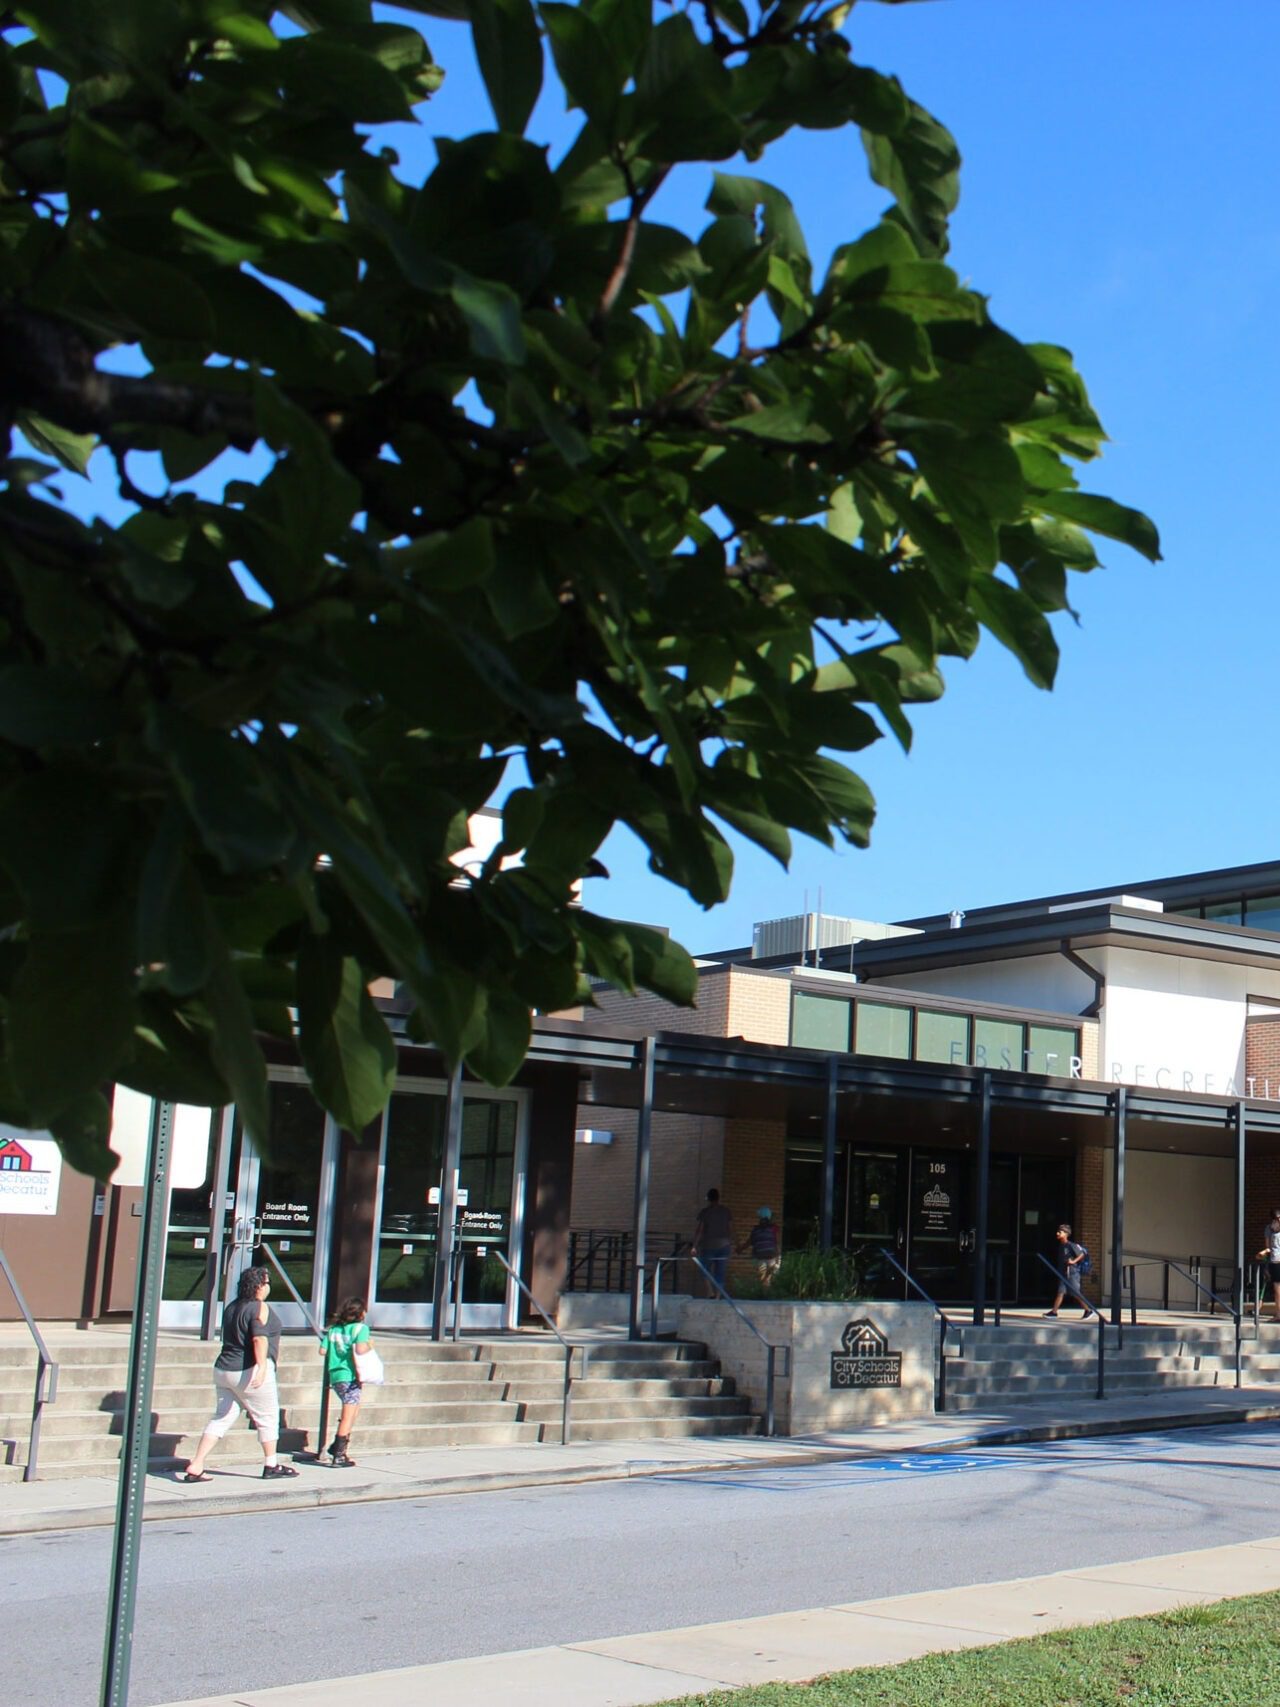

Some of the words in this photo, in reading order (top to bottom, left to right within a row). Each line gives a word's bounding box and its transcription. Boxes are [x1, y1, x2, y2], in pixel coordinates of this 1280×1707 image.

[930, 1163, 946, 1174] 105
[265, 1203, 286, 1211] Board
[288, 1203, 308, 1212] Room
[262, 1212, 292, 1221] Entrance
[294, 1213, 310, 1223] Only
[464, 1211, 483, 1220] Board
[484, 1212, 502, 1220] Room
[461, 1221, 488, 1229] Entrance
[489, 1222, 503, 1231] Only
[834, 1360, 857, 1375] City
[858, 1360, 899, 1372] Schools
[854, 1372, 899, 1384] Decatur
